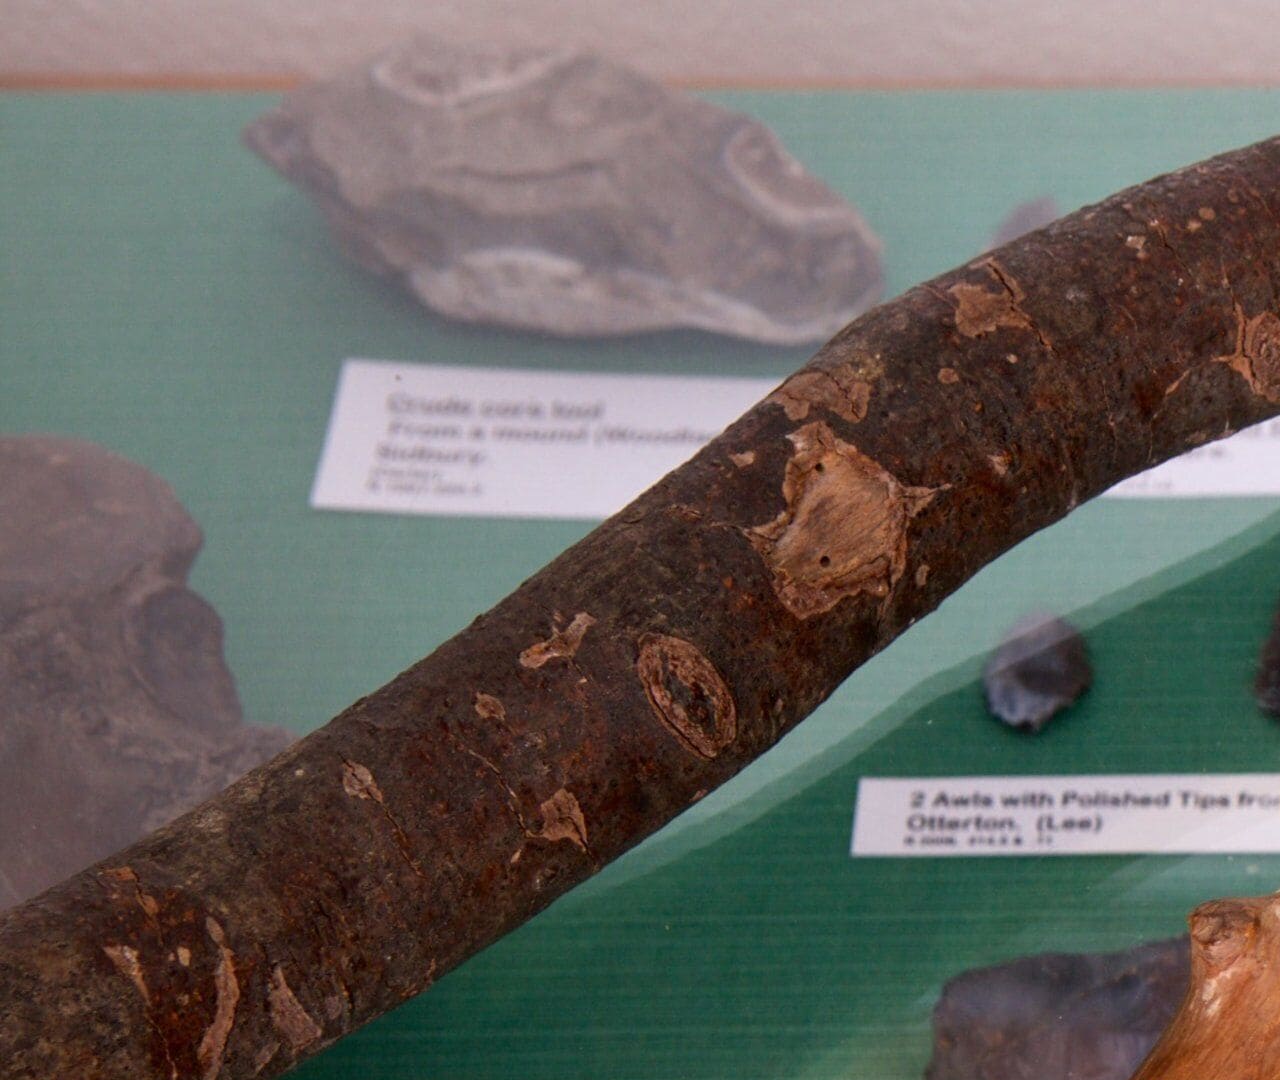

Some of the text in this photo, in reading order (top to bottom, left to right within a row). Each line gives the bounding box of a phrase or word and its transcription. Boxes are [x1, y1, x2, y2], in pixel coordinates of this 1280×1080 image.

[910, 791, 923, 809] 2
[932, 792, 993, 808] Awls
[1001, 792, 1054, 808] with
[1061, 791, 1170, 808] Polished
[1180, 791, 1230, 810] Tips
[905, 814, 1103, 834] Otterton. (Lee)
